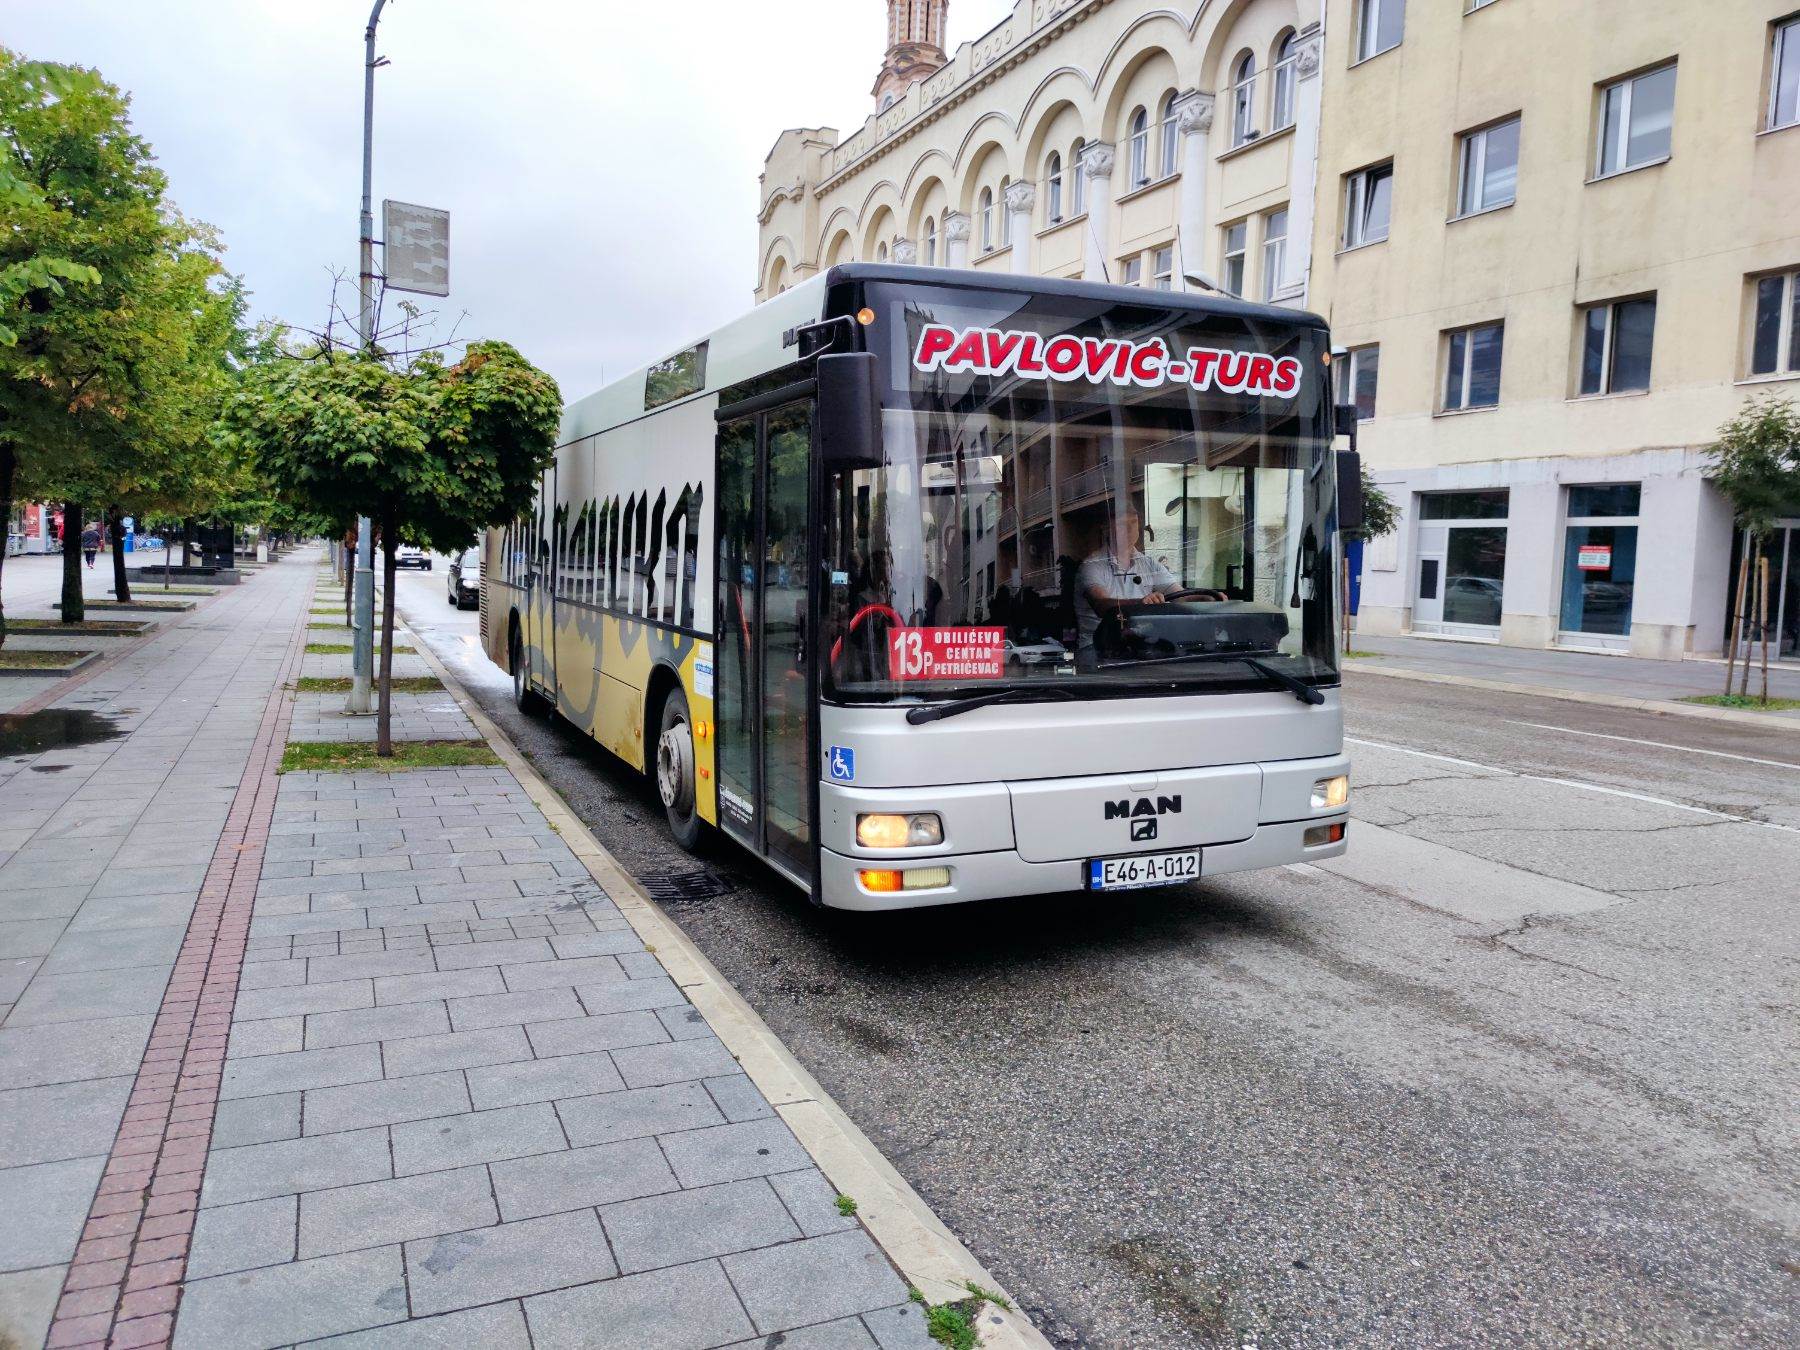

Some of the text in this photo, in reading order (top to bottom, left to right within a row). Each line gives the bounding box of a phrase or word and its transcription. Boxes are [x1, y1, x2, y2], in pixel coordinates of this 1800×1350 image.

[934, 629, 1000, 644] OBILIĆEVO
[946, 647, 992, 660] CENTAR
[934, 660, 999, 675] PETRIĆEVAC
[1104, 795, 1182, 820] MAN
[1104, 855, 1196, 883] E46-A-012
